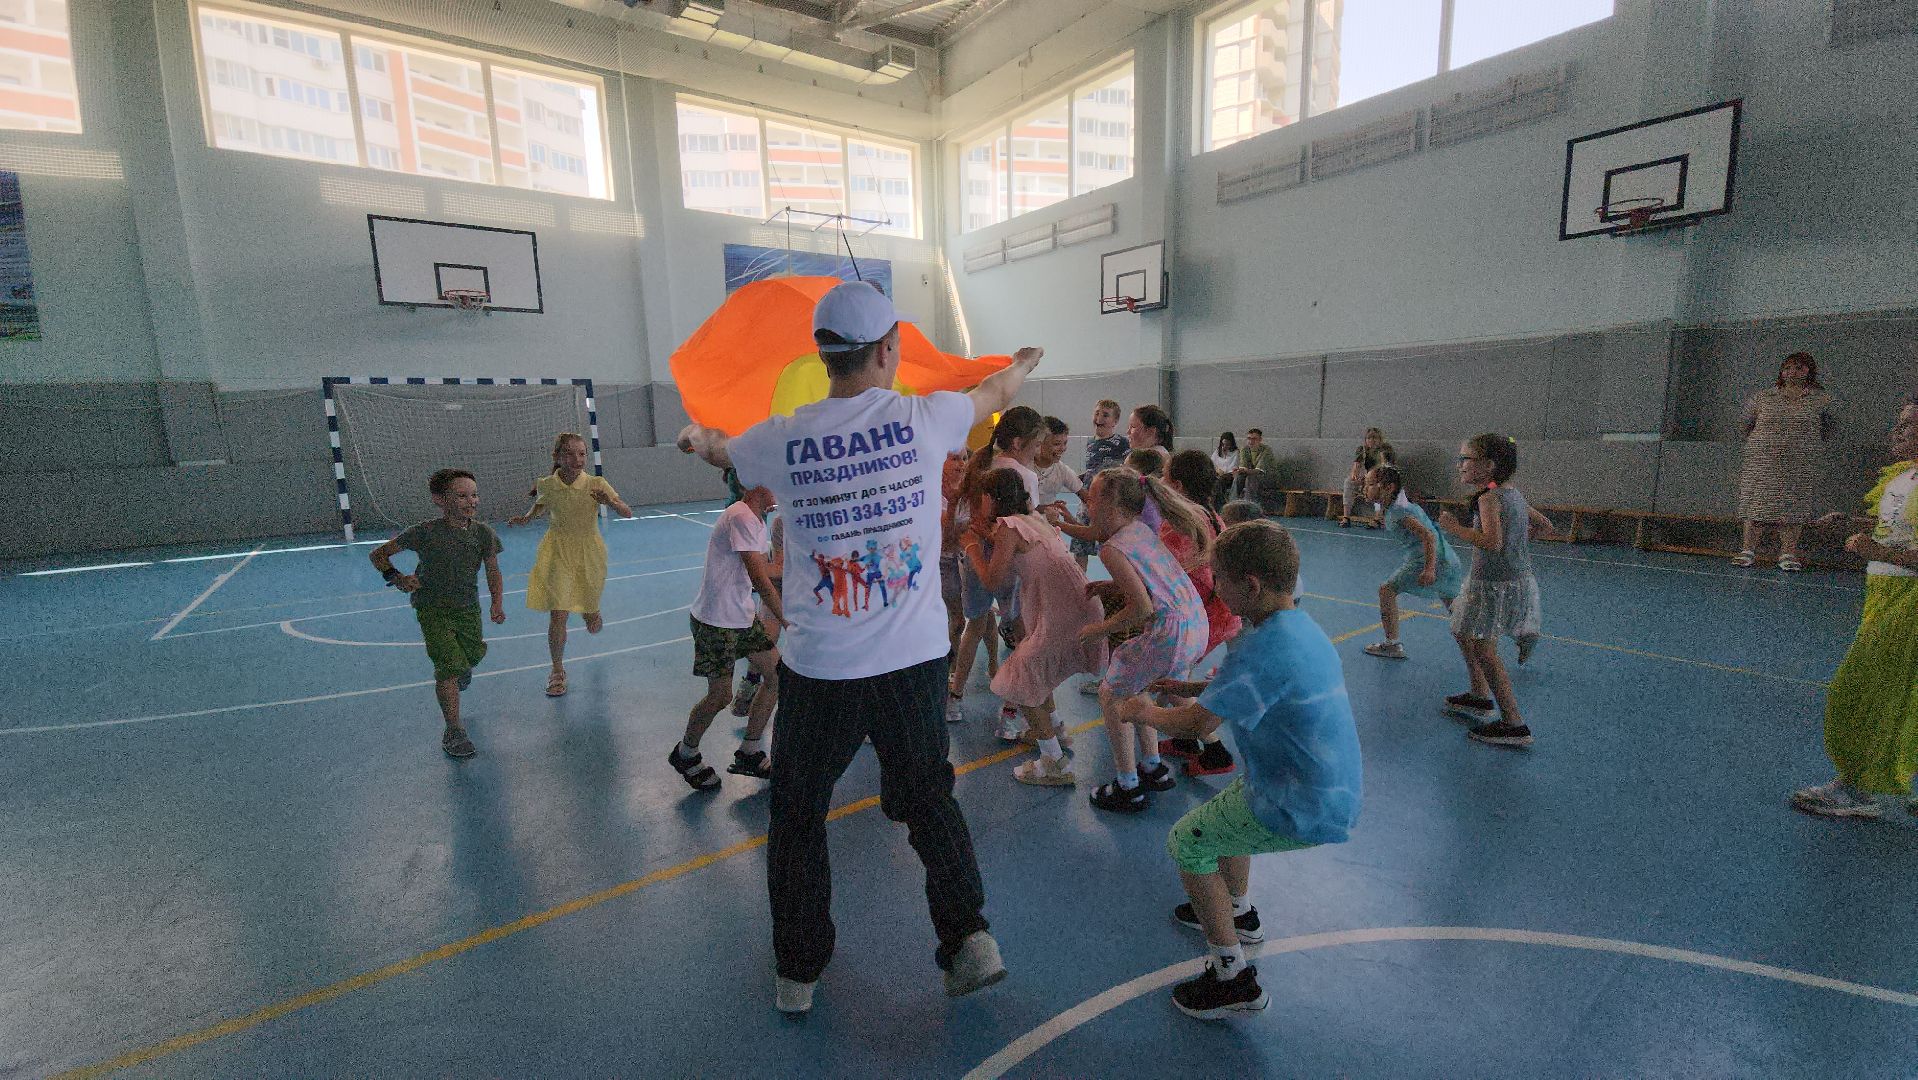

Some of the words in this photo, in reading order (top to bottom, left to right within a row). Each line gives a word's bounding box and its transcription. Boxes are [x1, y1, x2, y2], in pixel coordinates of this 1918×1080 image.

[786, 421, 914, 466] ГАВАНЬ
[790, 448, 918, 486] ПРАЗДНИКОВ!
[792, 498, 804, 508] ОТ
[806, 497, 819, 507] 30
[820, 491, 858, 505] МИНУТ
[861, 487, 877, 500] ДО
[879, 485, 887, 494] 5
[888, 474, 923, 491] ЧАСОВ!
[795, 508, 849, 529] +7(916)
[852, 489, 925, 522] 334-33-37
[831, 529, 862, 541] ГАВАНЬ
[863, 517, 914, 535] ПРАЗДНИКОВ
